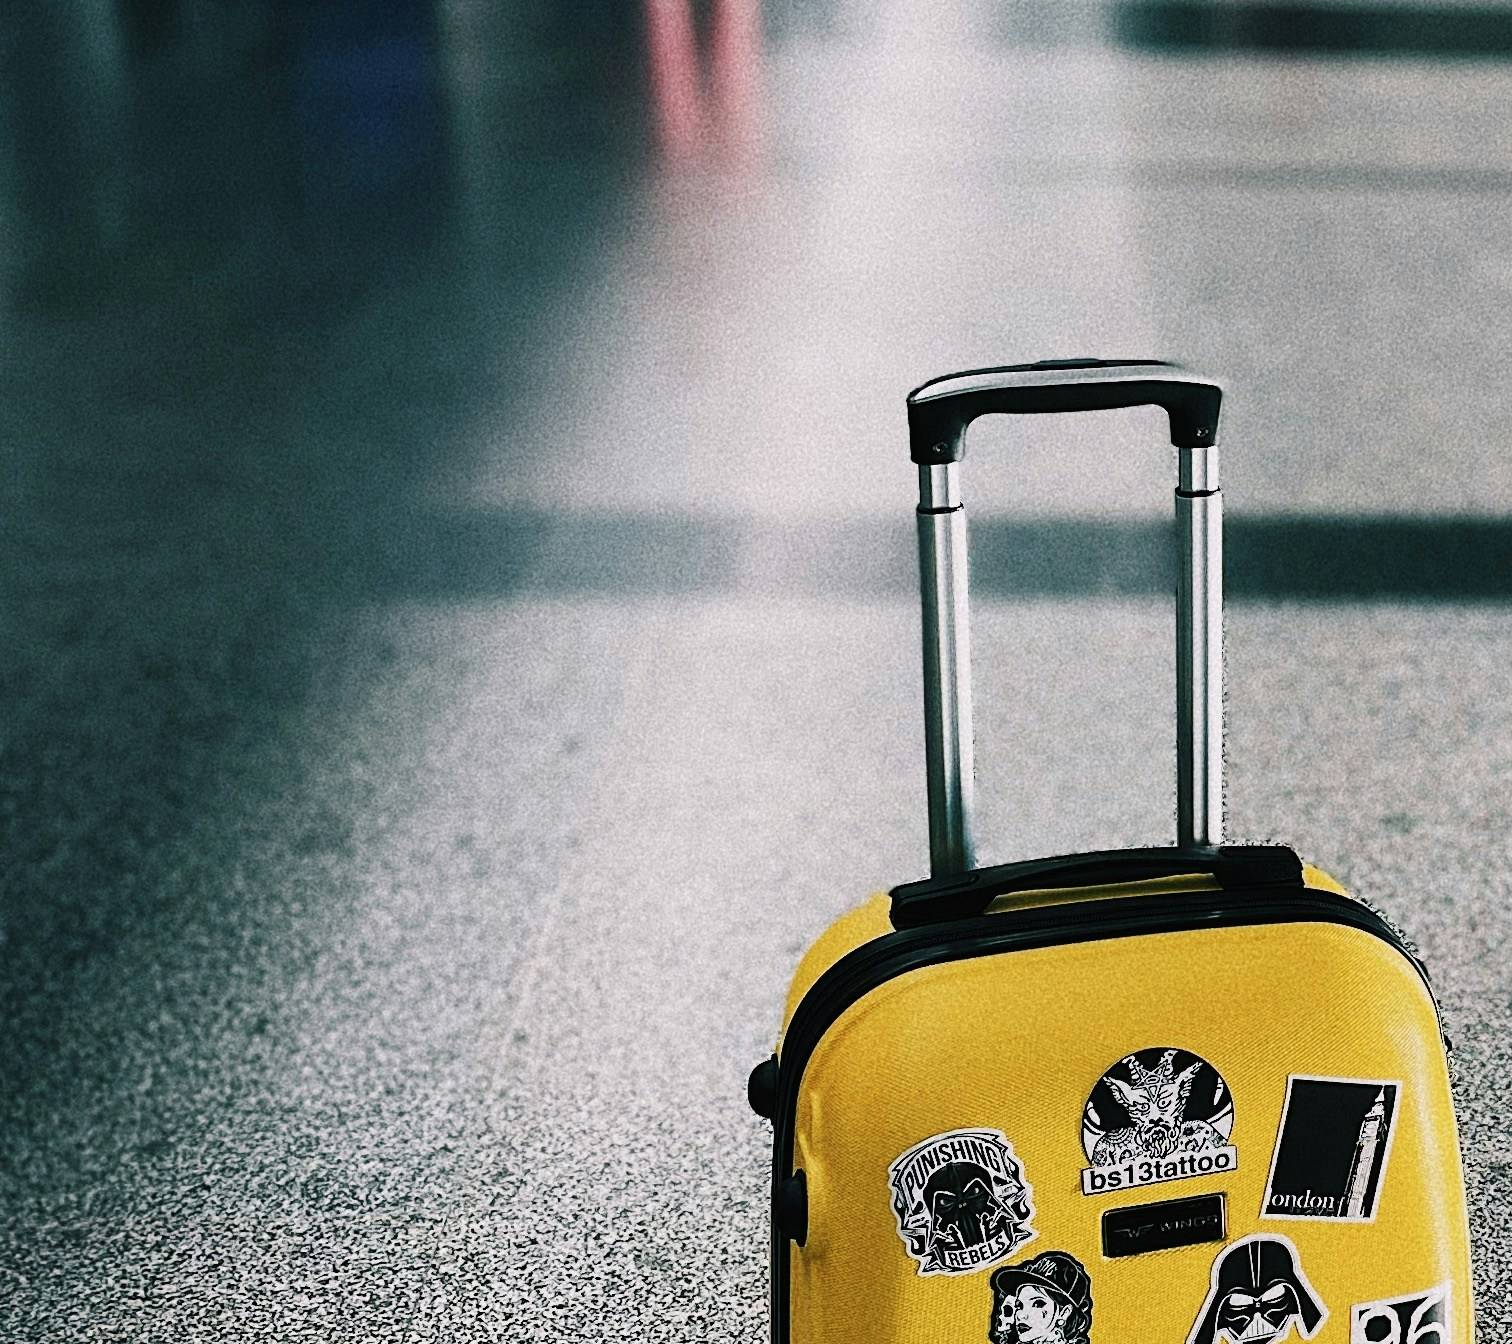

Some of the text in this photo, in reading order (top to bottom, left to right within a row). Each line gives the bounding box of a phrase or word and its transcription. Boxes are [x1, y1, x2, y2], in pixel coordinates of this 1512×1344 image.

[904, 1139, 1002, 1204] PUNISHING
[1090, 1152, 1230, 1191] bs13tattoo
[947, 1234, 1007, 1266] REBELS
